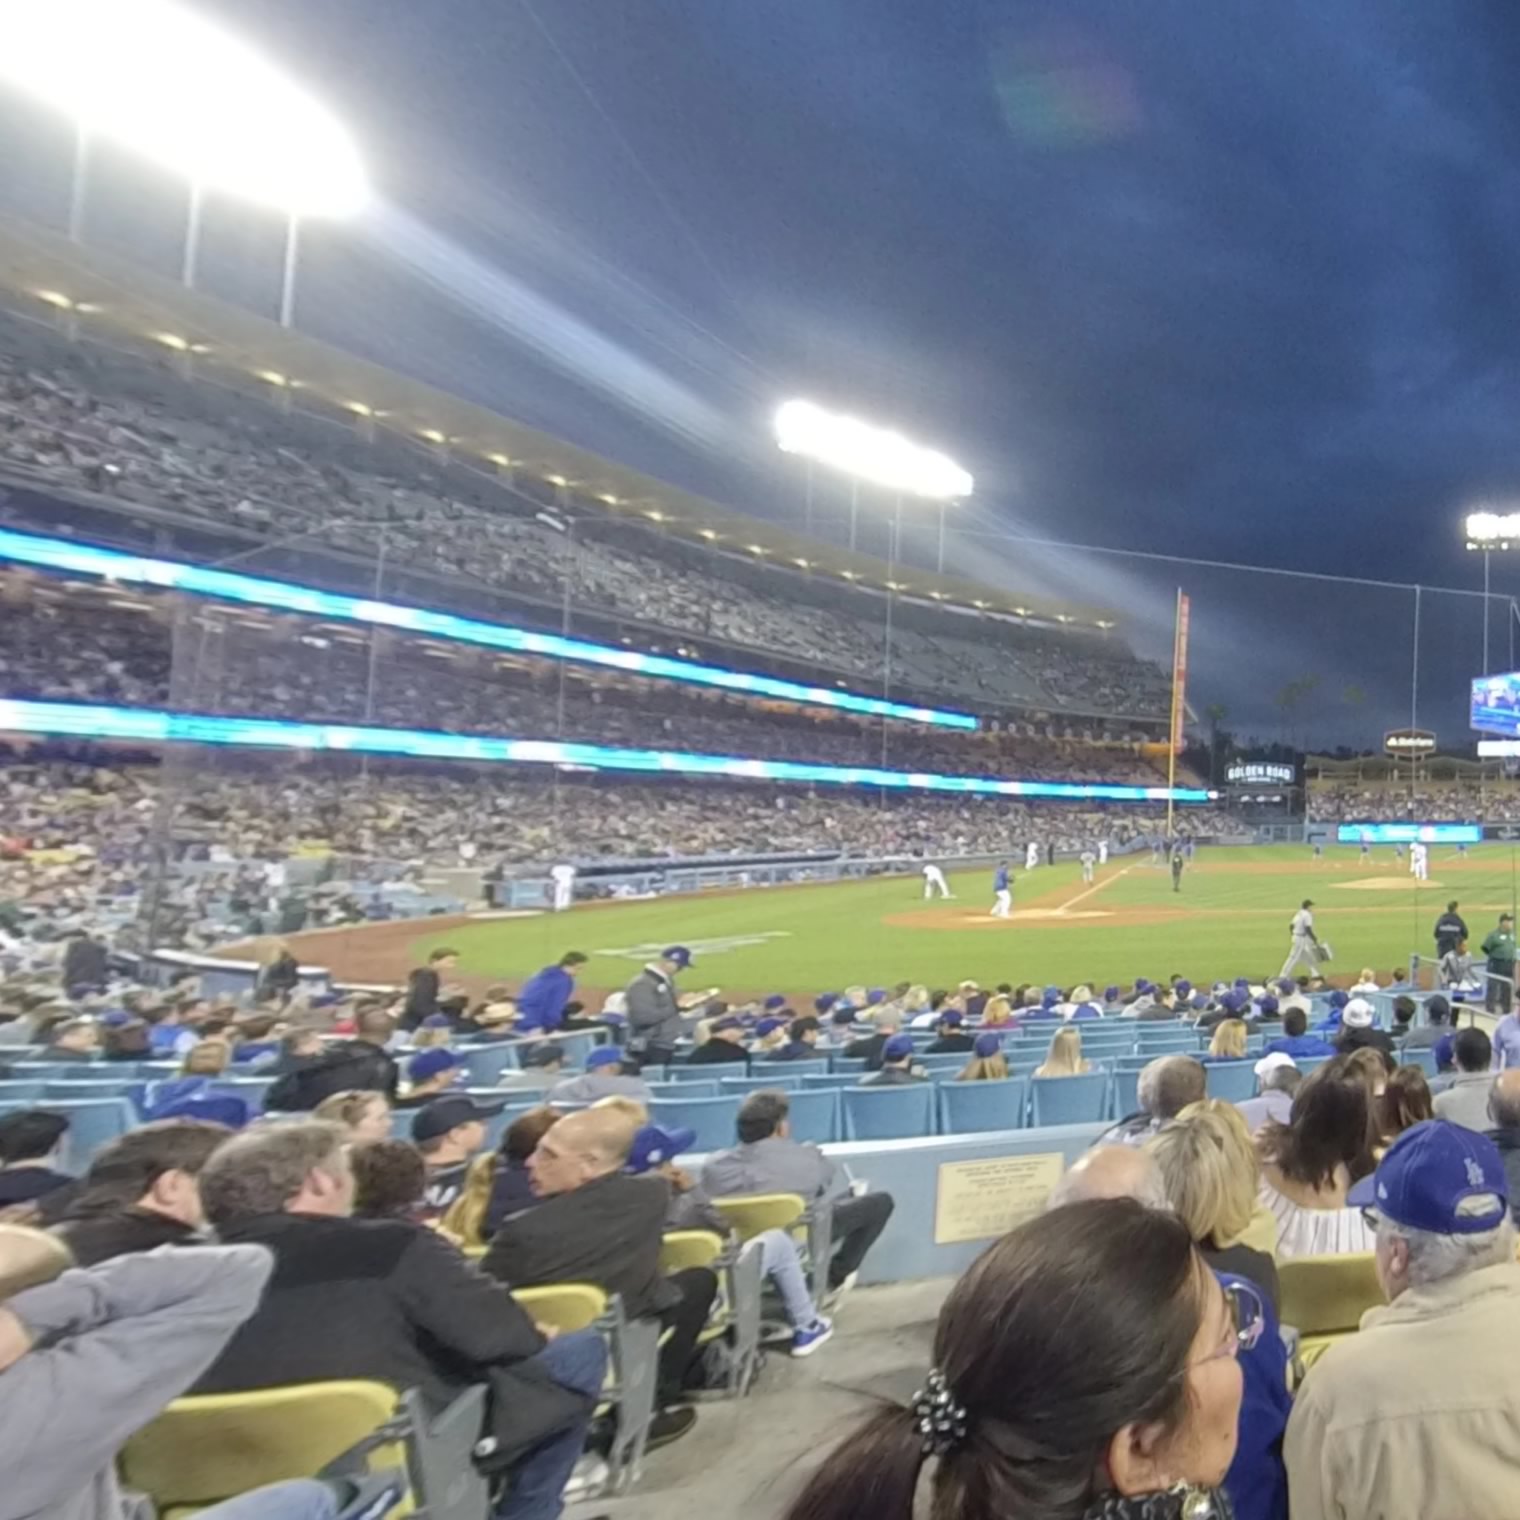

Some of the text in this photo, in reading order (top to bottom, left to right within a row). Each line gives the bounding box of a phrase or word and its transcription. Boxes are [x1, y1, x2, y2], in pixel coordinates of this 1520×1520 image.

[1228, 765, 1291, 780] GOLDEN ROAD
[1464, 1157, 1484, 1185] LA
